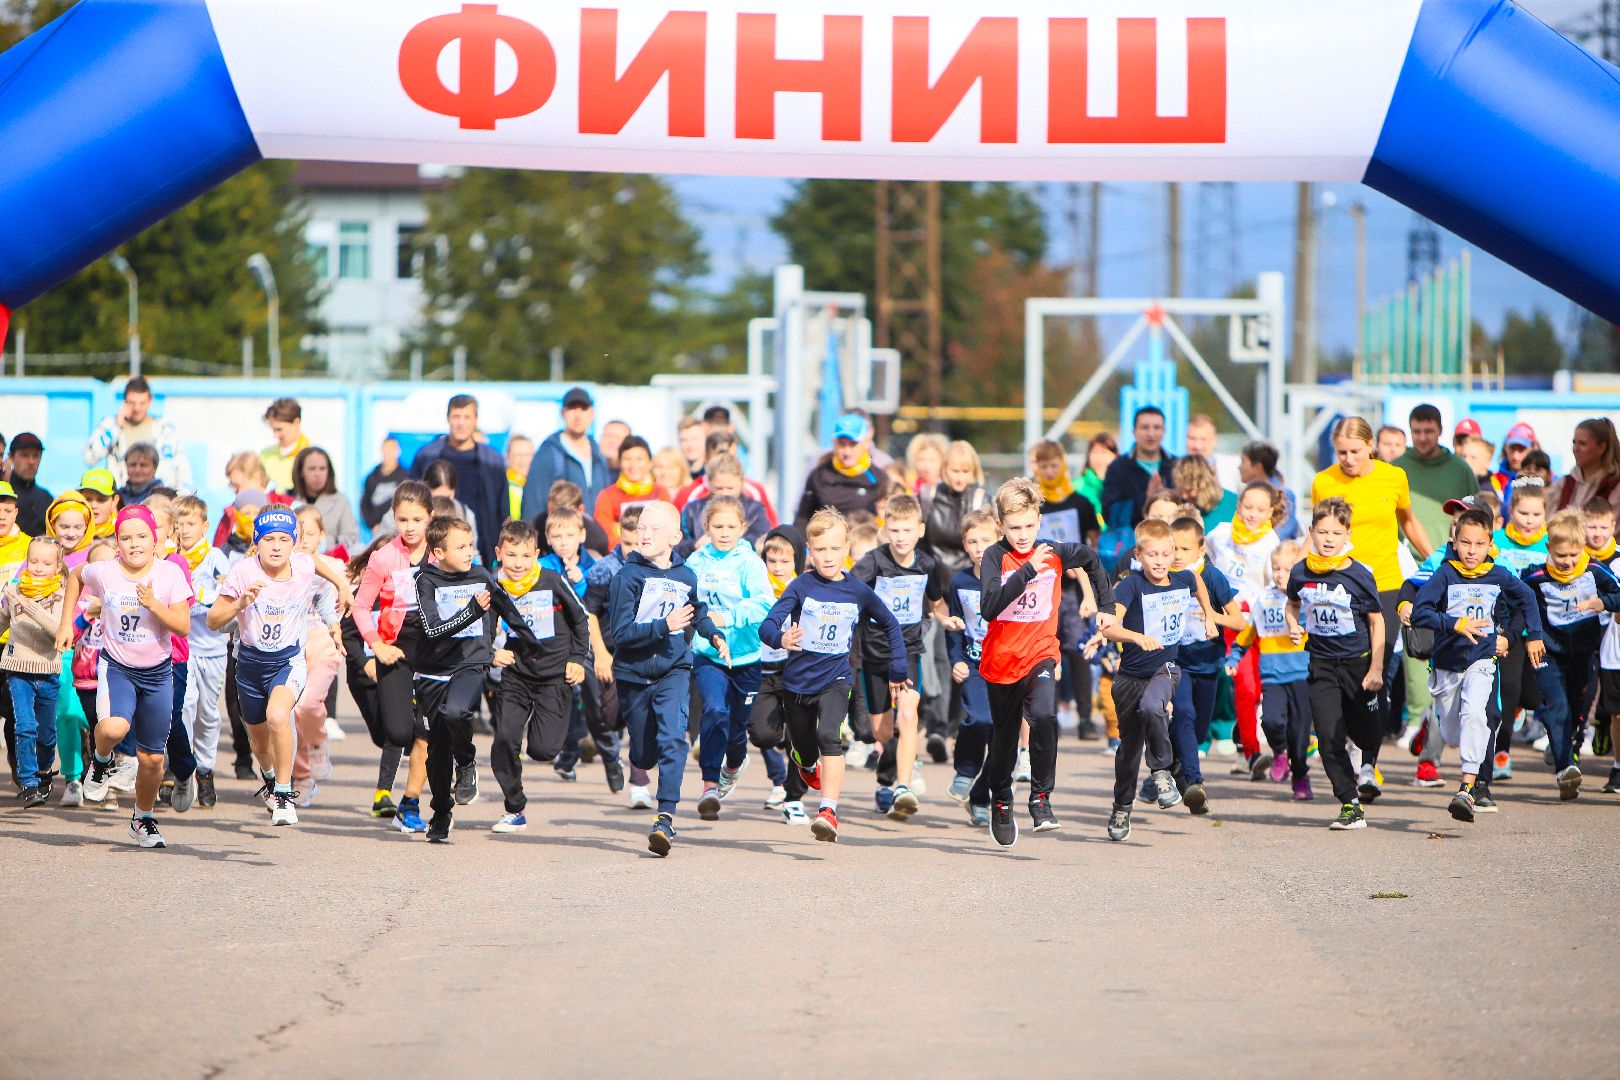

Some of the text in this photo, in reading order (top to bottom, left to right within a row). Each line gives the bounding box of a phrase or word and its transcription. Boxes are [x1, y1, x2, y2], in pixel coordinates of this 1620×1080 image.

[398, 3, 1227, 143] ФИНИШ
[258, 513, 293, 527] LUKOIL
[892, 597, 910, 612] 94
[1017, 591, 1038, 609] 43
[120, 614, 141, 632] 97
[1262, 608, 1284, 623] 135
[1312, 608, 1339, 624] 144
[261, 623, 282, 640] 98
[818, 623, 838, 641] 18
